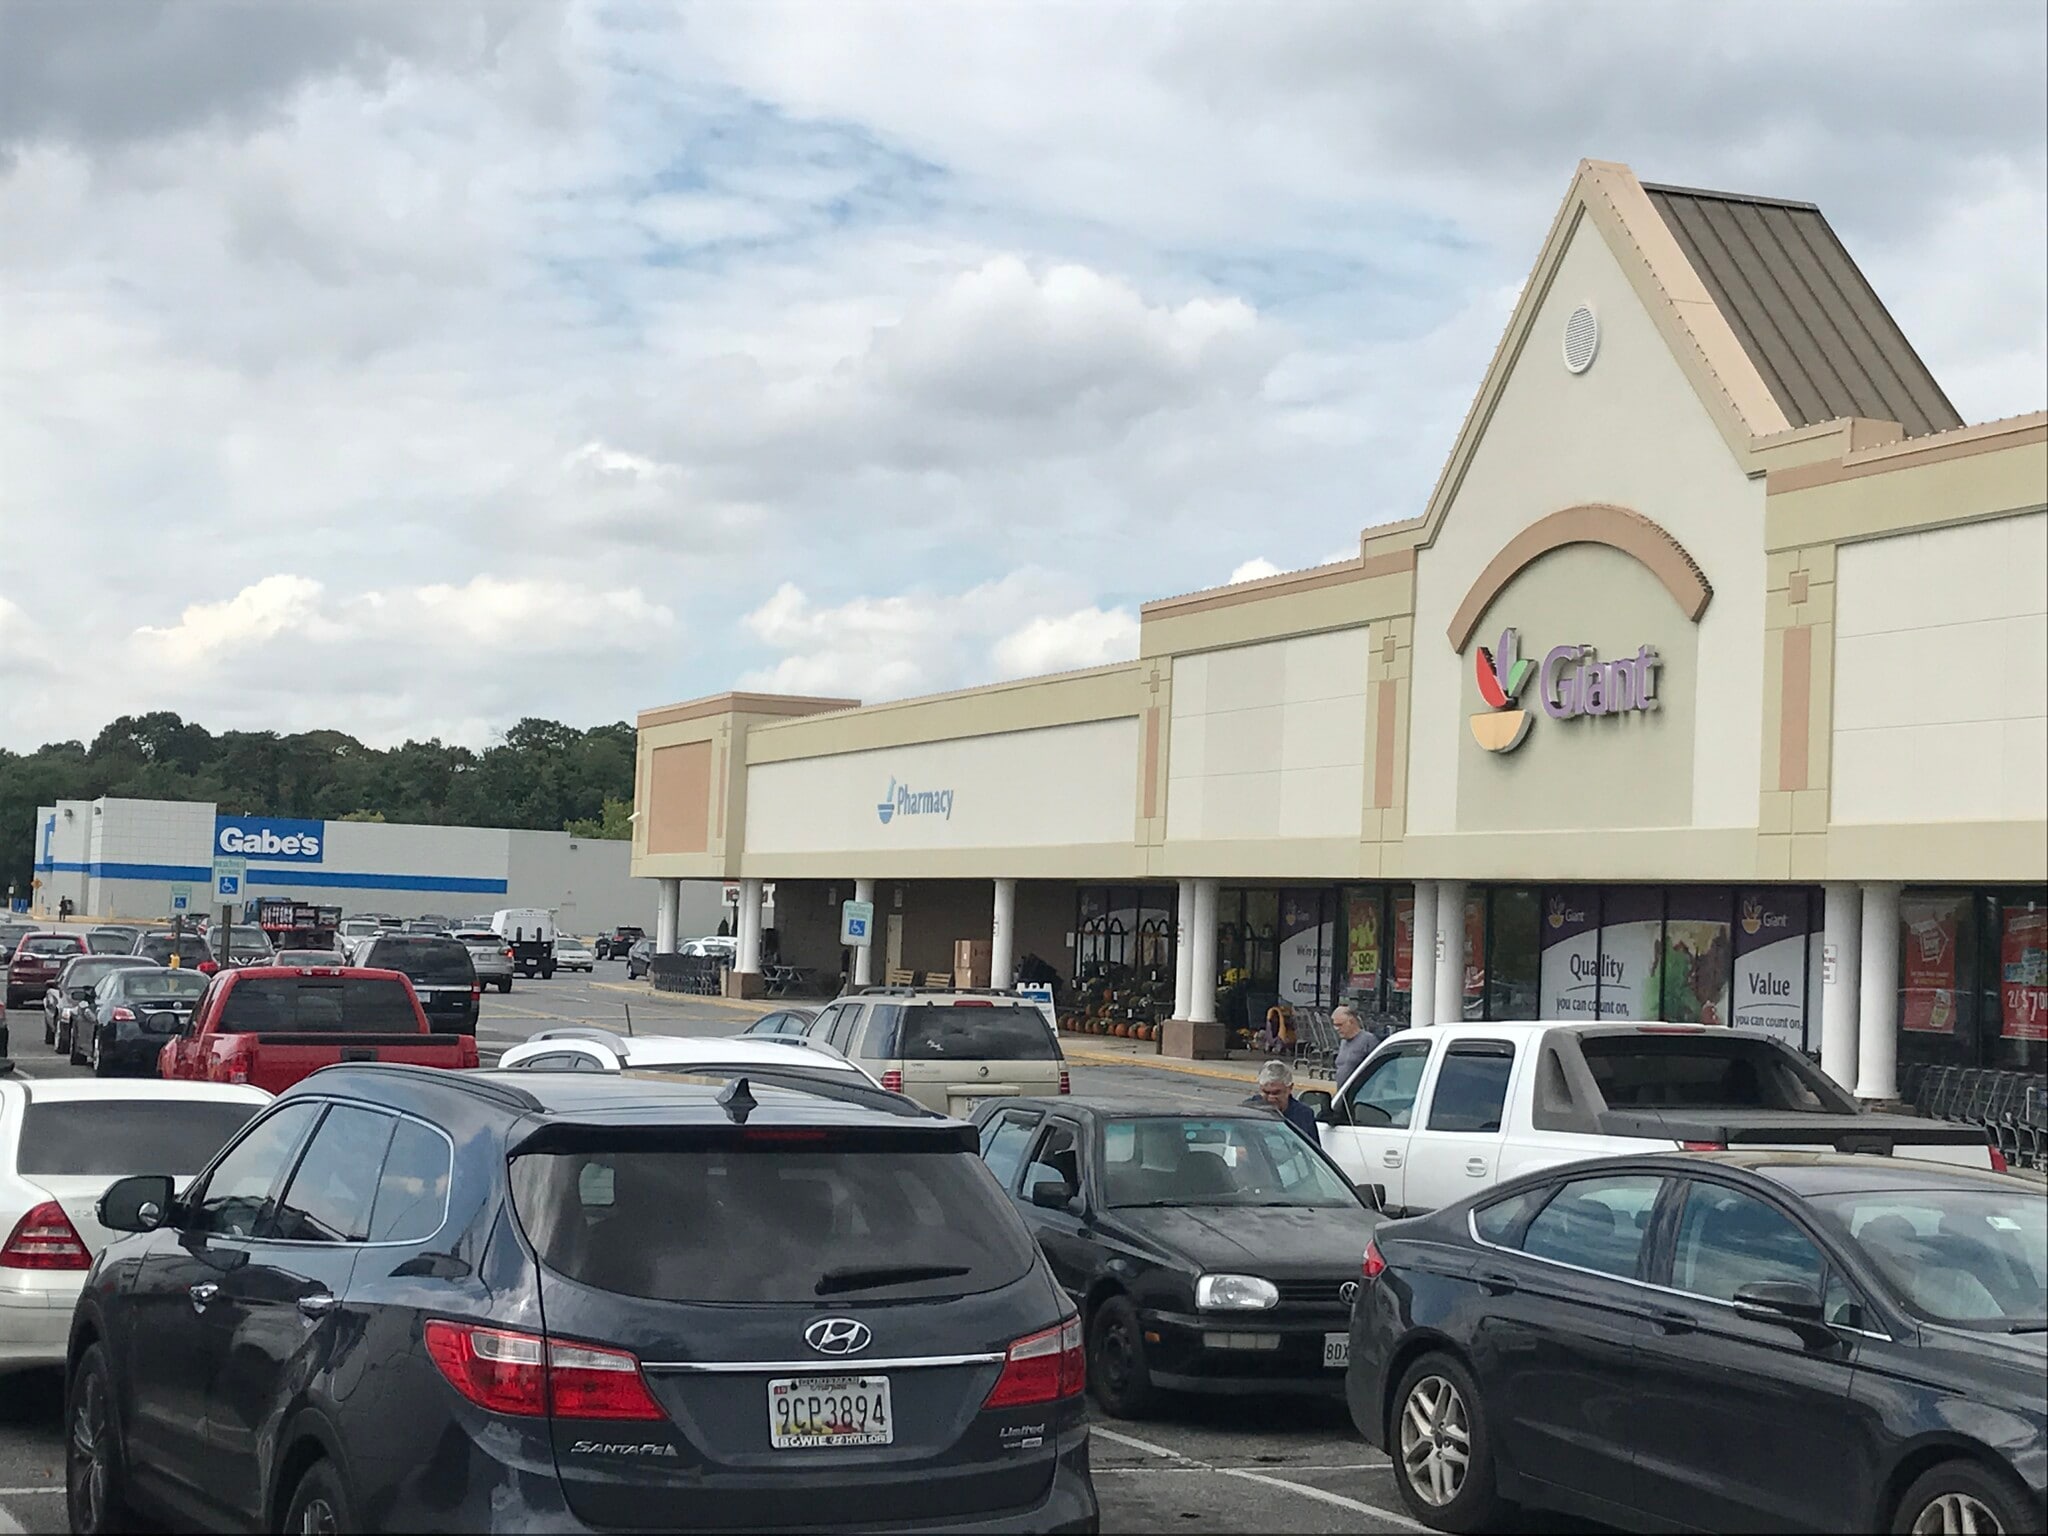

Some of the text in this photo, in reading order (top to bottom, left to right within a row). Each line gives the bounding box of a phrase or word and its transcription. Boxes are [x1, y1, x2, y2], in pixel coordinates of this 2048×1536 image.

[1540, 644, 1661, 719] Giant
[897, 783, 954, 821] Pharmacy
[1763, 912, 1788, 927] Giant
[1570, 953, 1624, 984] Quality
[1749, 972, 1790, 997] Value
[1556, 998, 1571, 1015] you
[1572, 999, 1587, 1012] can
[1734, 1015, 1750, 1029] you
[1751, 1016, 1765, 1027] can
[1765, 1017, 1788, 1029] count
[777, 1394, 886, 1433] 9CP3894
[779, 1436, 826, 1448] BOWIE
